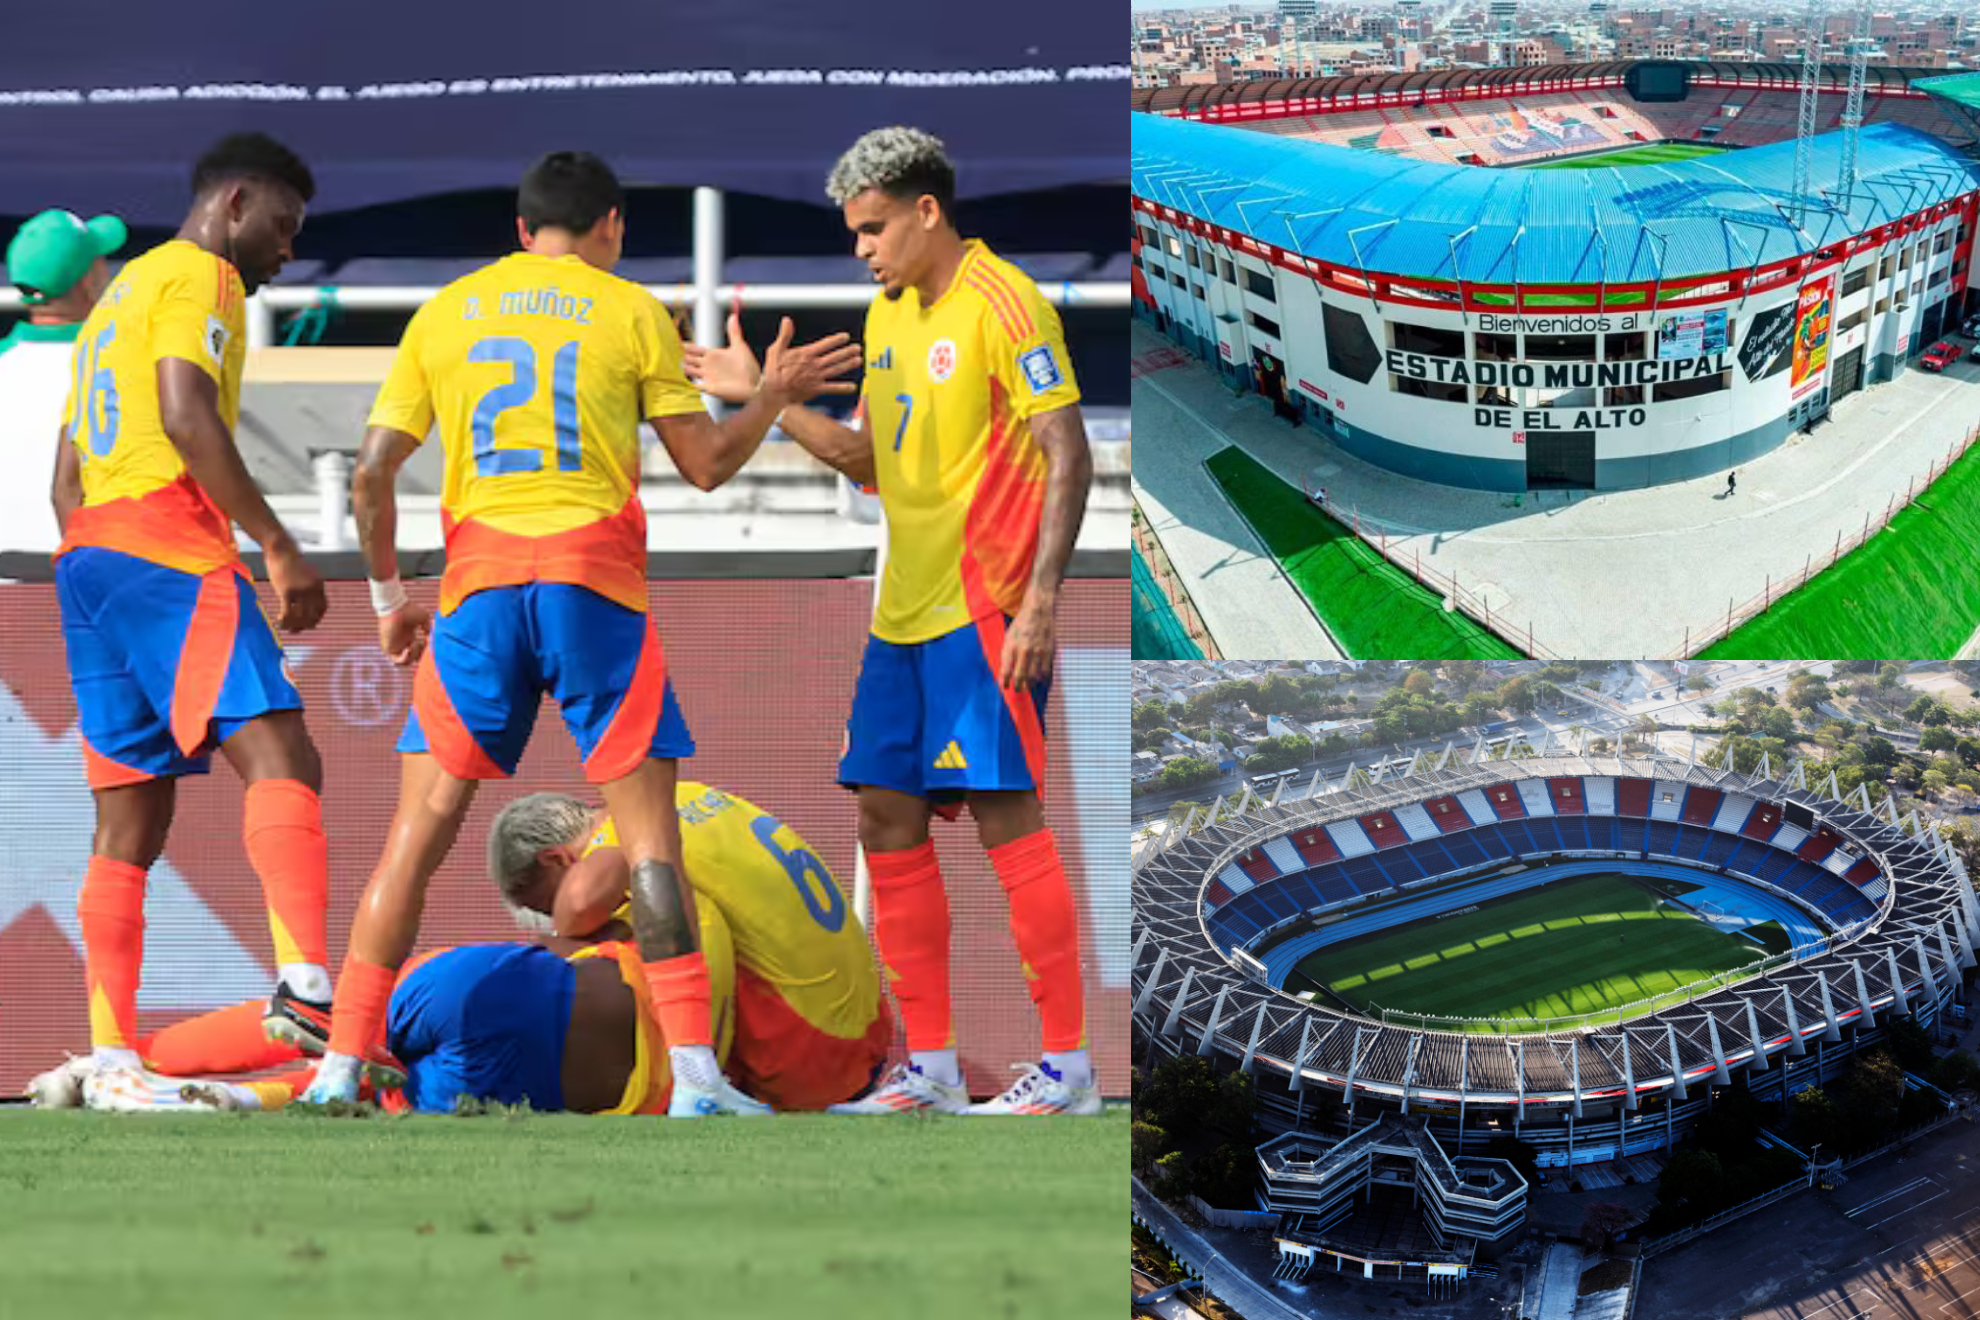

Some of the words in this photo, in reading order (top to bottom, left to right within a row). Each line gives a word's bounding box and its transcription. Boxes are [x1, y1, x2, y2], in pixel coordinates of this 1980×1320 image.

[316, 87, 350, 101] EL
[499, 285, 594, 326] MUÑOZ
[1479, 314, 1612, 333] Bienvenidos
[1621, 312, 1639, 331] al
[1386, 350, 1534, 387] ESTADIO
[1544, 353, 1734, 387] MUNICIPAL
[468, 335, 583, 477] 21
[894, 393, 913, 452] 7
[1475, 407, 1512, 429] DE
[1523, 410, 1561, 430] EL
[1573, 408, 1646, 430] ALTO
[750, 816, 846, 931] 6
